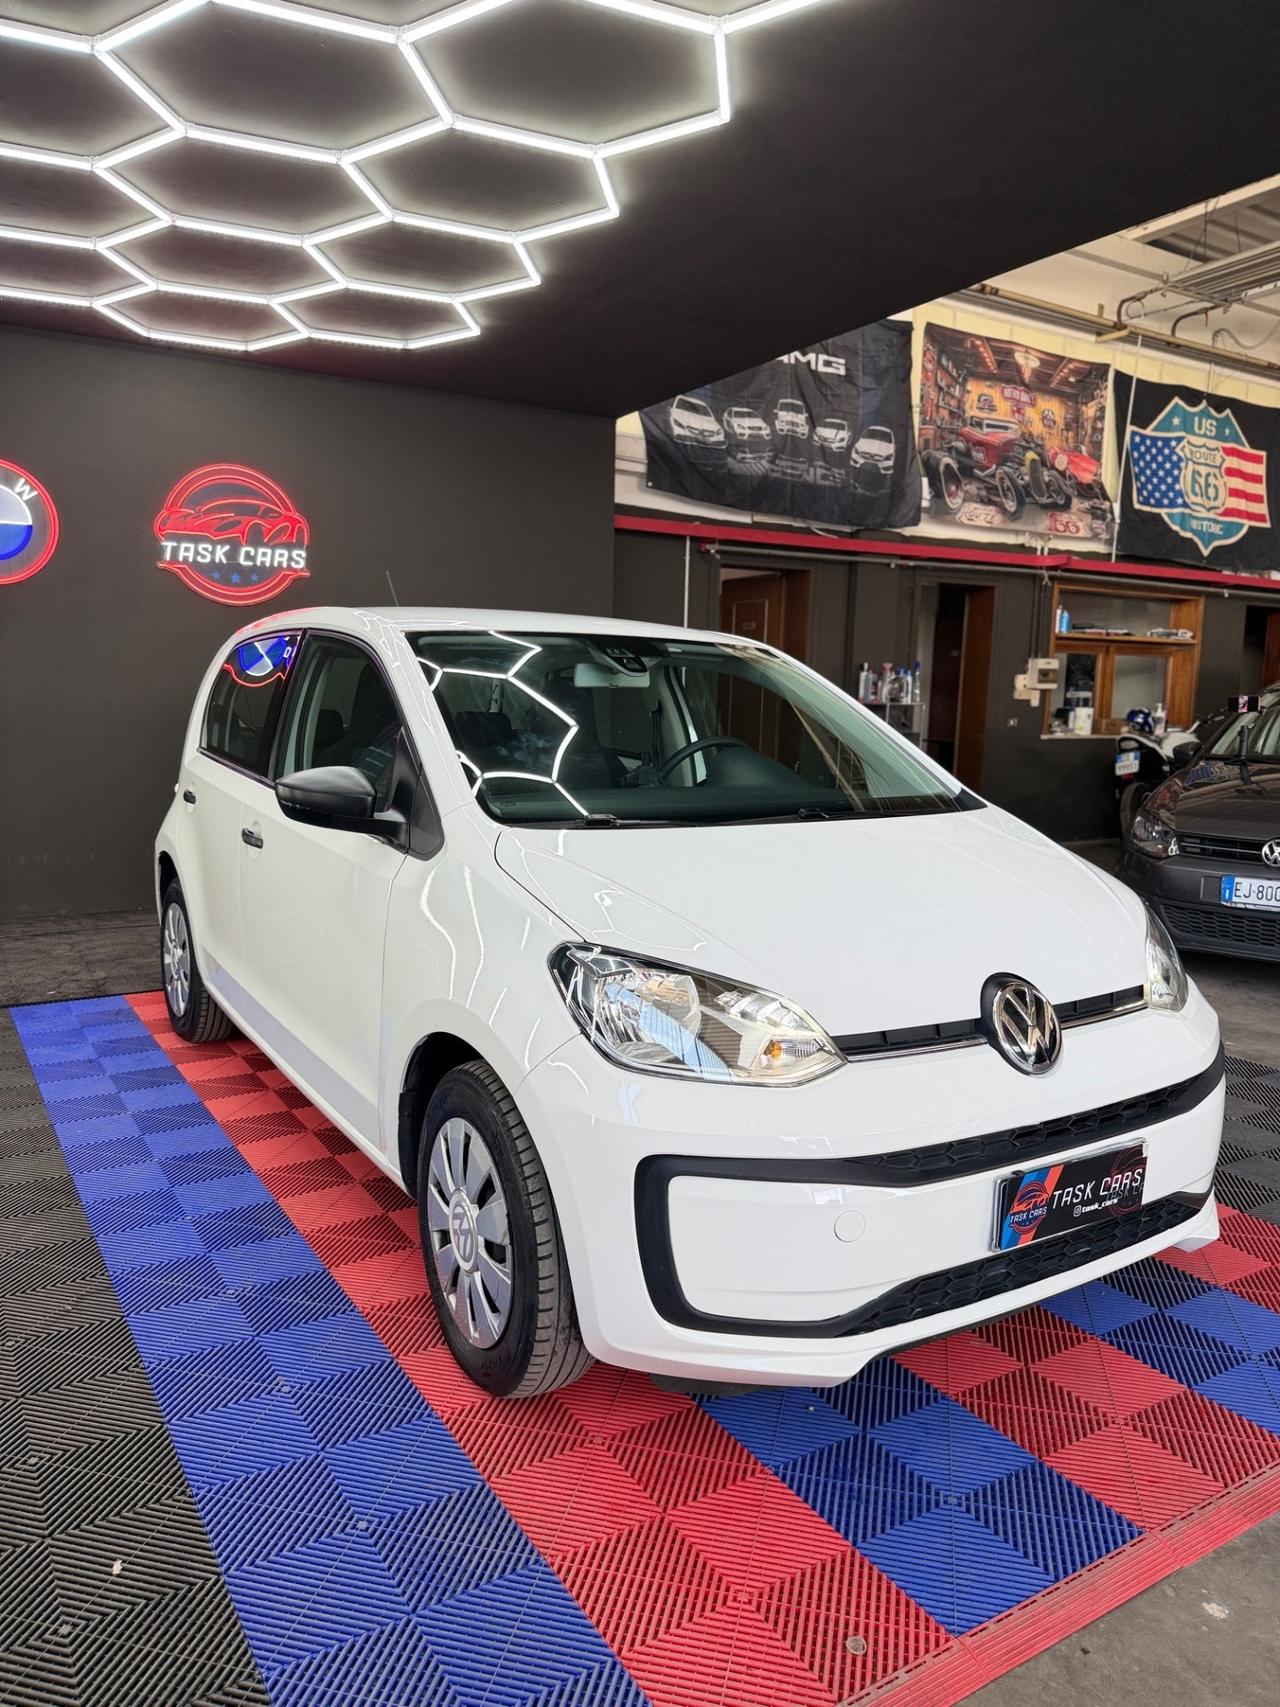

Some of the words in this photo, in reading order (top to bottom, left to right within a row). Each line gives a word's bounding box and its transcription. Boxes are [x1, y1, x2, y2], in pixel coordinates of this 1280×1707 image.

[1194, 416, 1217, 437] US
[1190, 469, 1219, 502] 66
[161, 541, 230, 565] TASK
[239, 546, 307, 568] CARS
[1053, 1180, 1096, 1210] TASK
[1100, 1169, 1143, 1195] CARS
[1010, 1211, 1028, 1223] TASK
